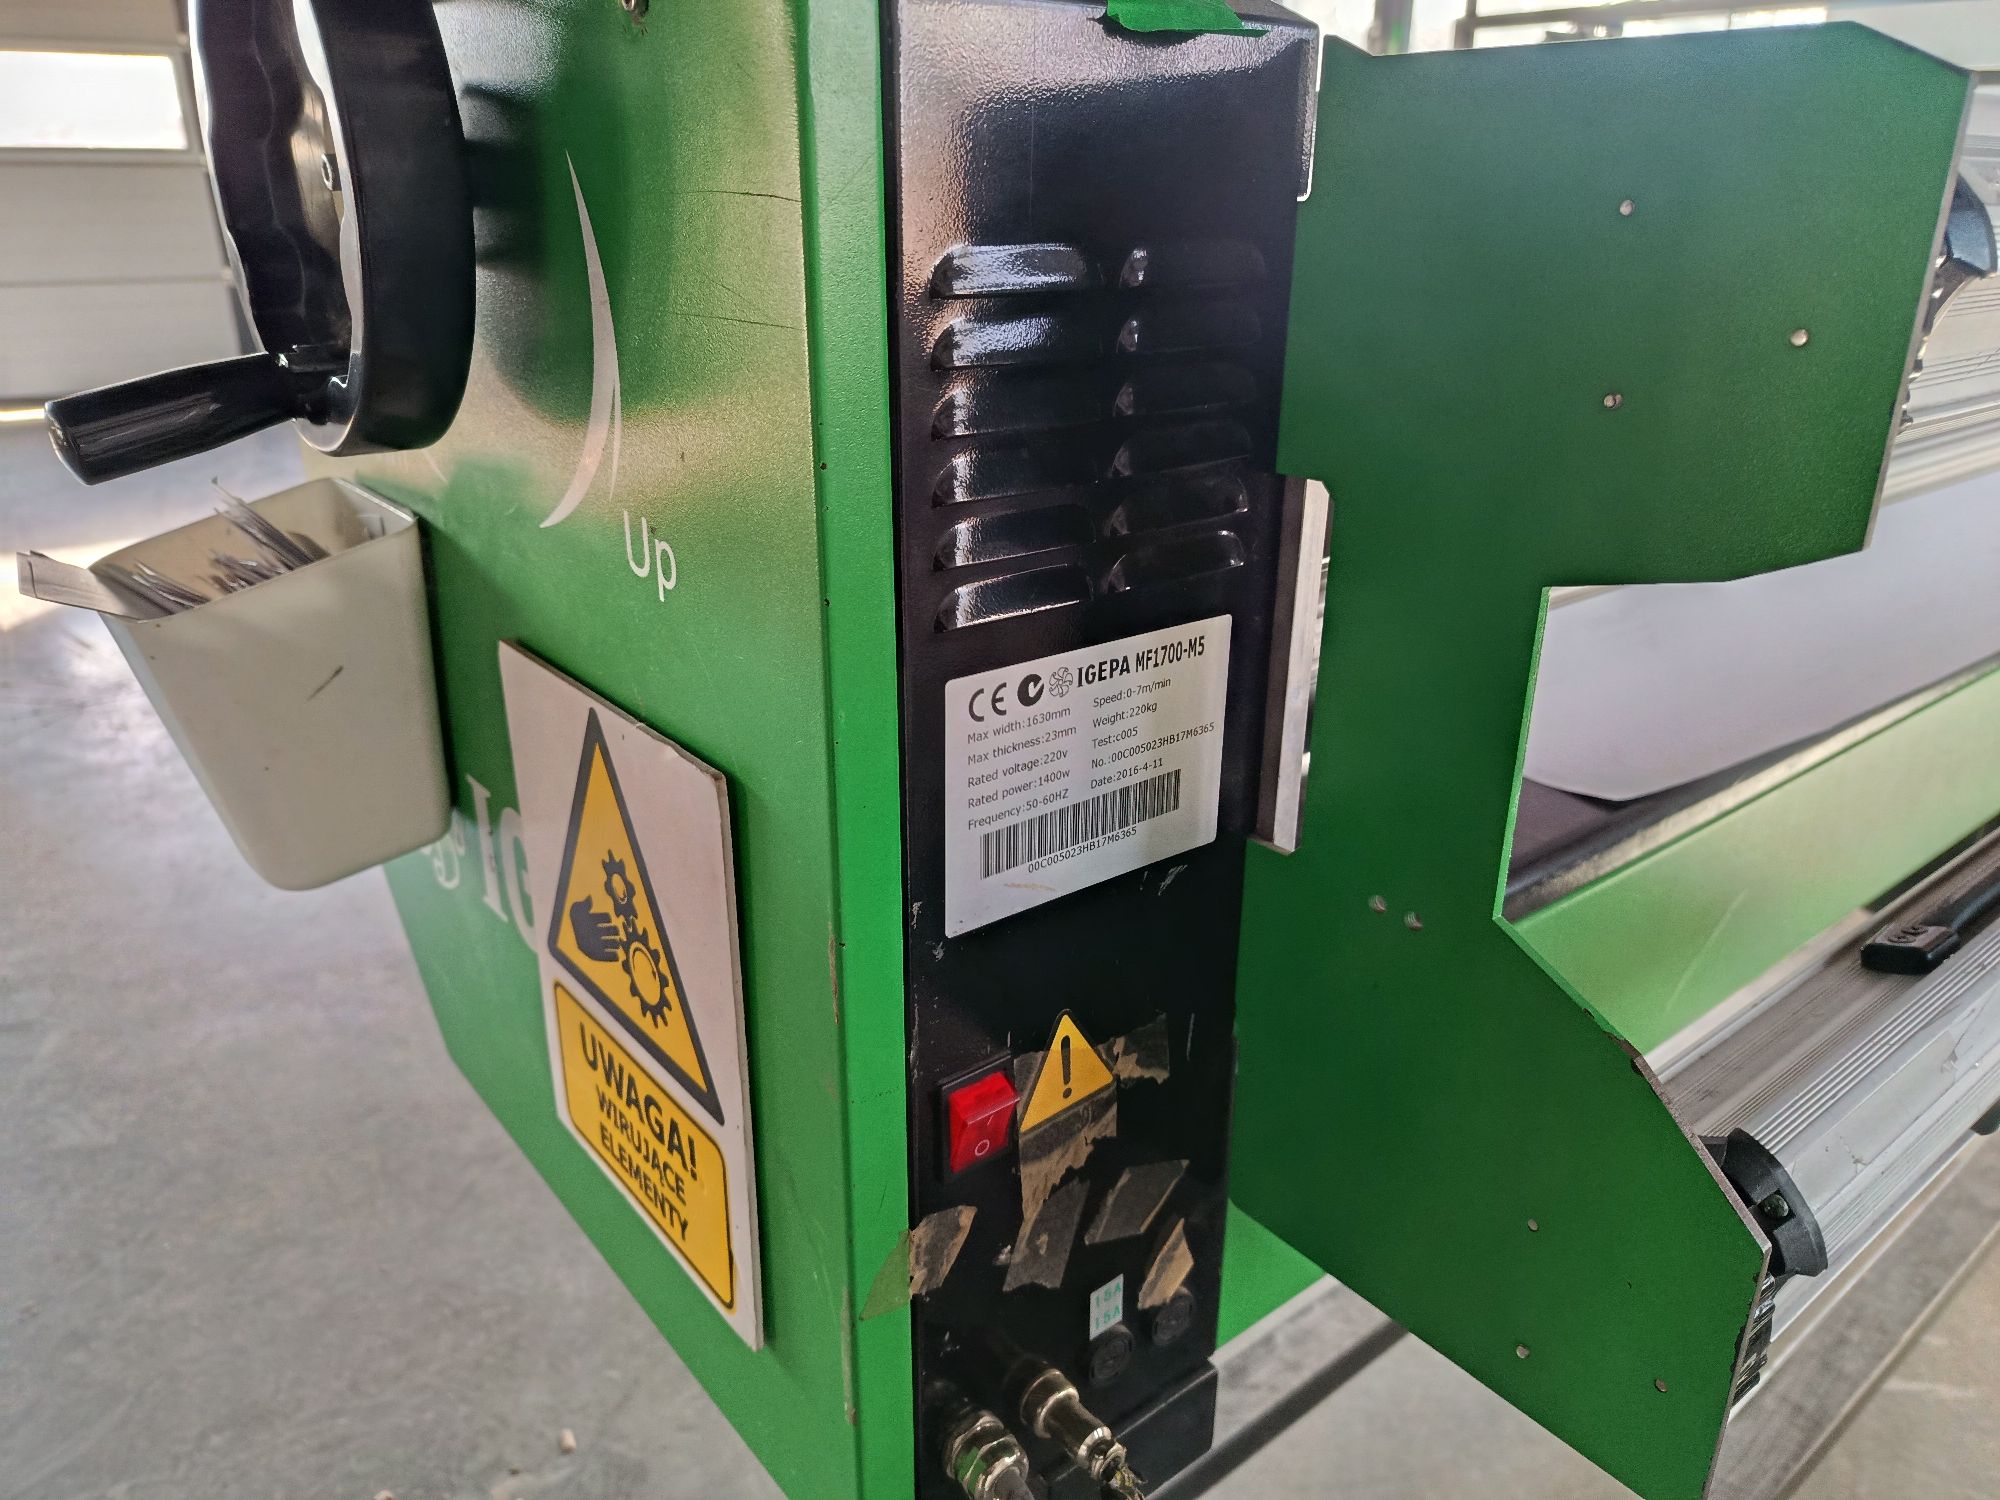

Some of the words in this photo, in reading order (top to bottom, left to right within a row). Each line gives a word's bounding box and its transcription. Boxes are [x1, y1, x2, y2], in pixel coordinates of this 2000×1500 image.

[623, 511, 678, 602] Up
[1077, 655, 1131, 688] IGEPA
[1135, 635, 1205, 673] MF1700-M5
[1093, 678, 1171, 708] Speed:0-7m/min
[967, 730, 989, 745] Max
[992, 707, 1071, 737] width:1630mm
[1092, 702, 1158, 728] Weight:220kg
[967, 752, 989, 766] Max
[992, 726, 1077, 759] thickness:23mm
[1092, 726, 1139, 749] Test:c005
[967, 769, 999, 788] Rated
[1002, 749, 1069, 778] voltage:220v
[1090, 757, 1164, 789] Date:2016-4-11
[967, 793, 999, 809] Rated
[1002, 769, 1071, 800] power:1400w
[968, 788, 1070, 830] Frequency:50-60HZ
[579, 1021, 698, 1181] UWAGA!
[600, 1121, 689, 1242] ELEMENTY
